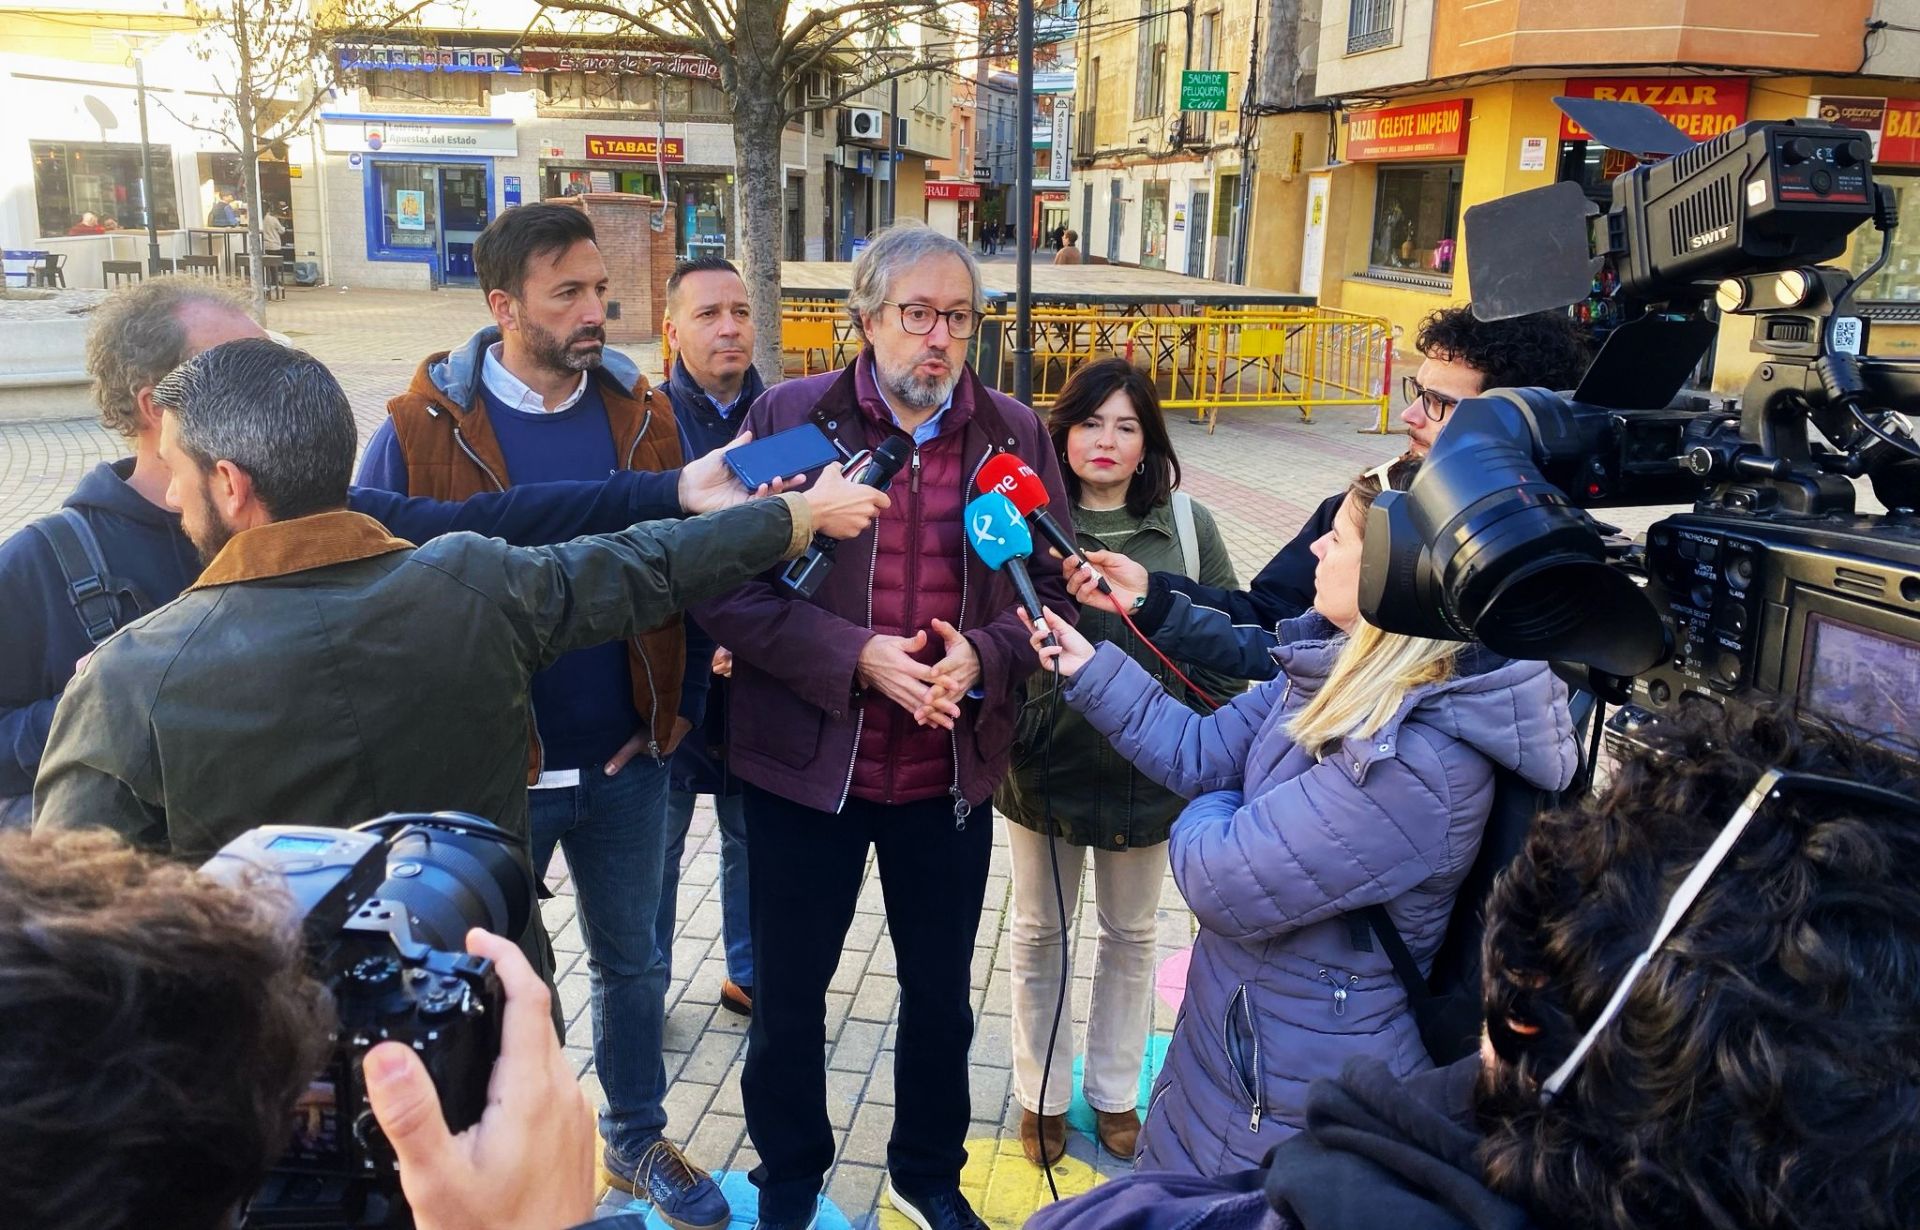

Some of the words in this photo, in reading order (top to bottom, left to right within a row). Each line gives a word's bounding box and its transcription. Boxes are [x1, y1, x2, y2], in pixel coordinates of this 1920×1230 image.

[1188, 73, 1211, 84] SALON
[1211, 74, 1222, 85] DE
[1593, 85, 1718, 105] BAZAR
[1350, 119, 1377, 142] BAZAR
[1378, 114, 1415, 139] CELESTE
[1416, 109, 1460, 135] IMPERIO
[389, 134, 429, 144] Apuestas
[431, 134, 445, 144] del
[447, 135, 477, 145] Estado
[606, 140, 677, 154] TABACS
[1692, 226, 1729, 248] SWIT
[991, 475, 1018, 494] ne
